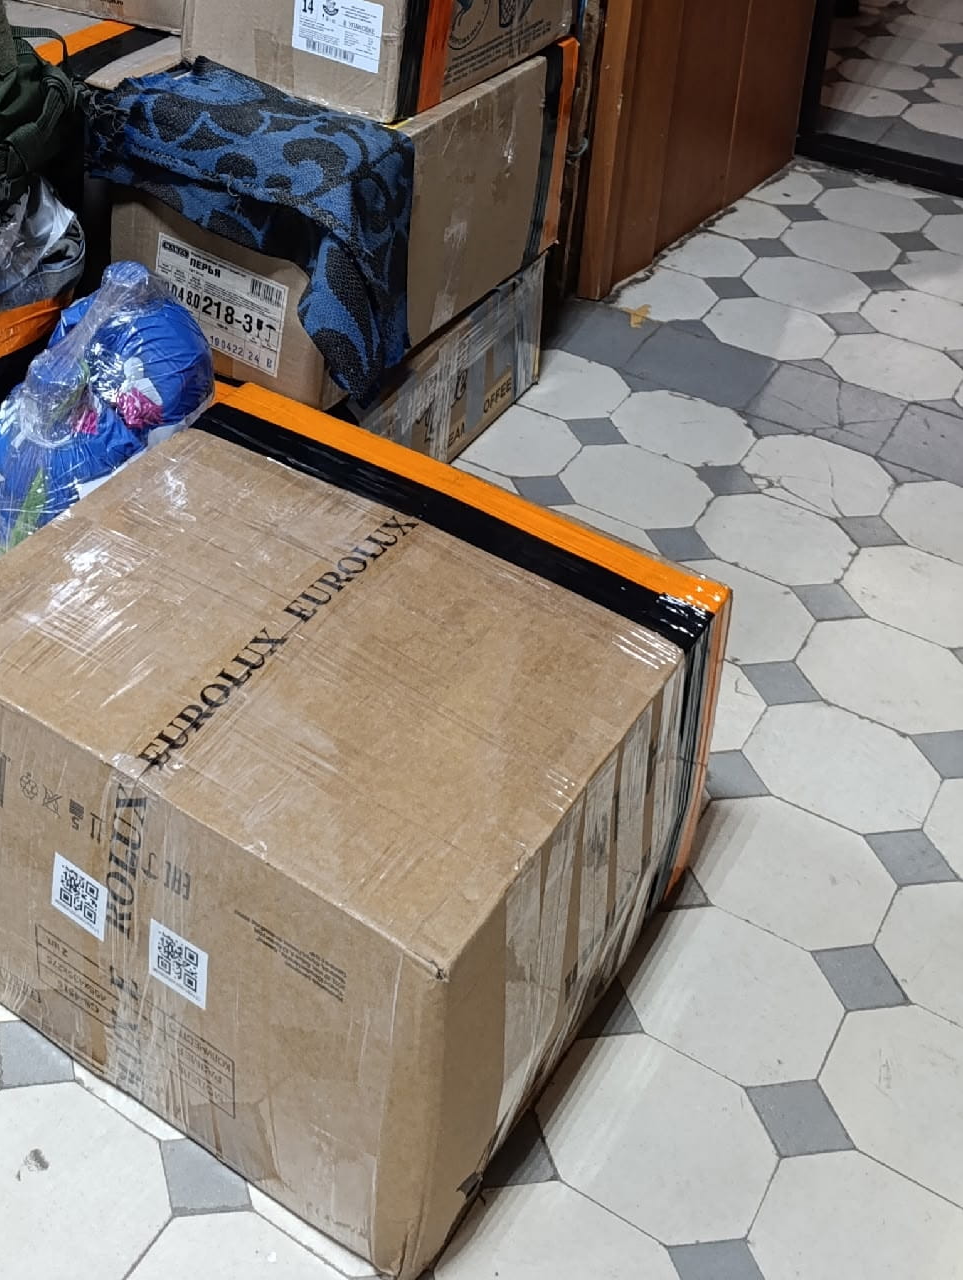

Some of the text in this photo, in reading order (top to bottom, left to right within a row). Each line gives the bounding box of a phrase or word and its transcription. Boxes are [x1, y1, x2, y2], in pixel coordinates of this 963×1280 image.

[190, 257, 221, 278] ПЕРЬЯ
[202, 295, 253, 334] 218-3
[483, 377, 513, 414] OFFEE
[283, 515, 420, 622] EUROLUX
[138, 628, 289, 770] EUROLUX
